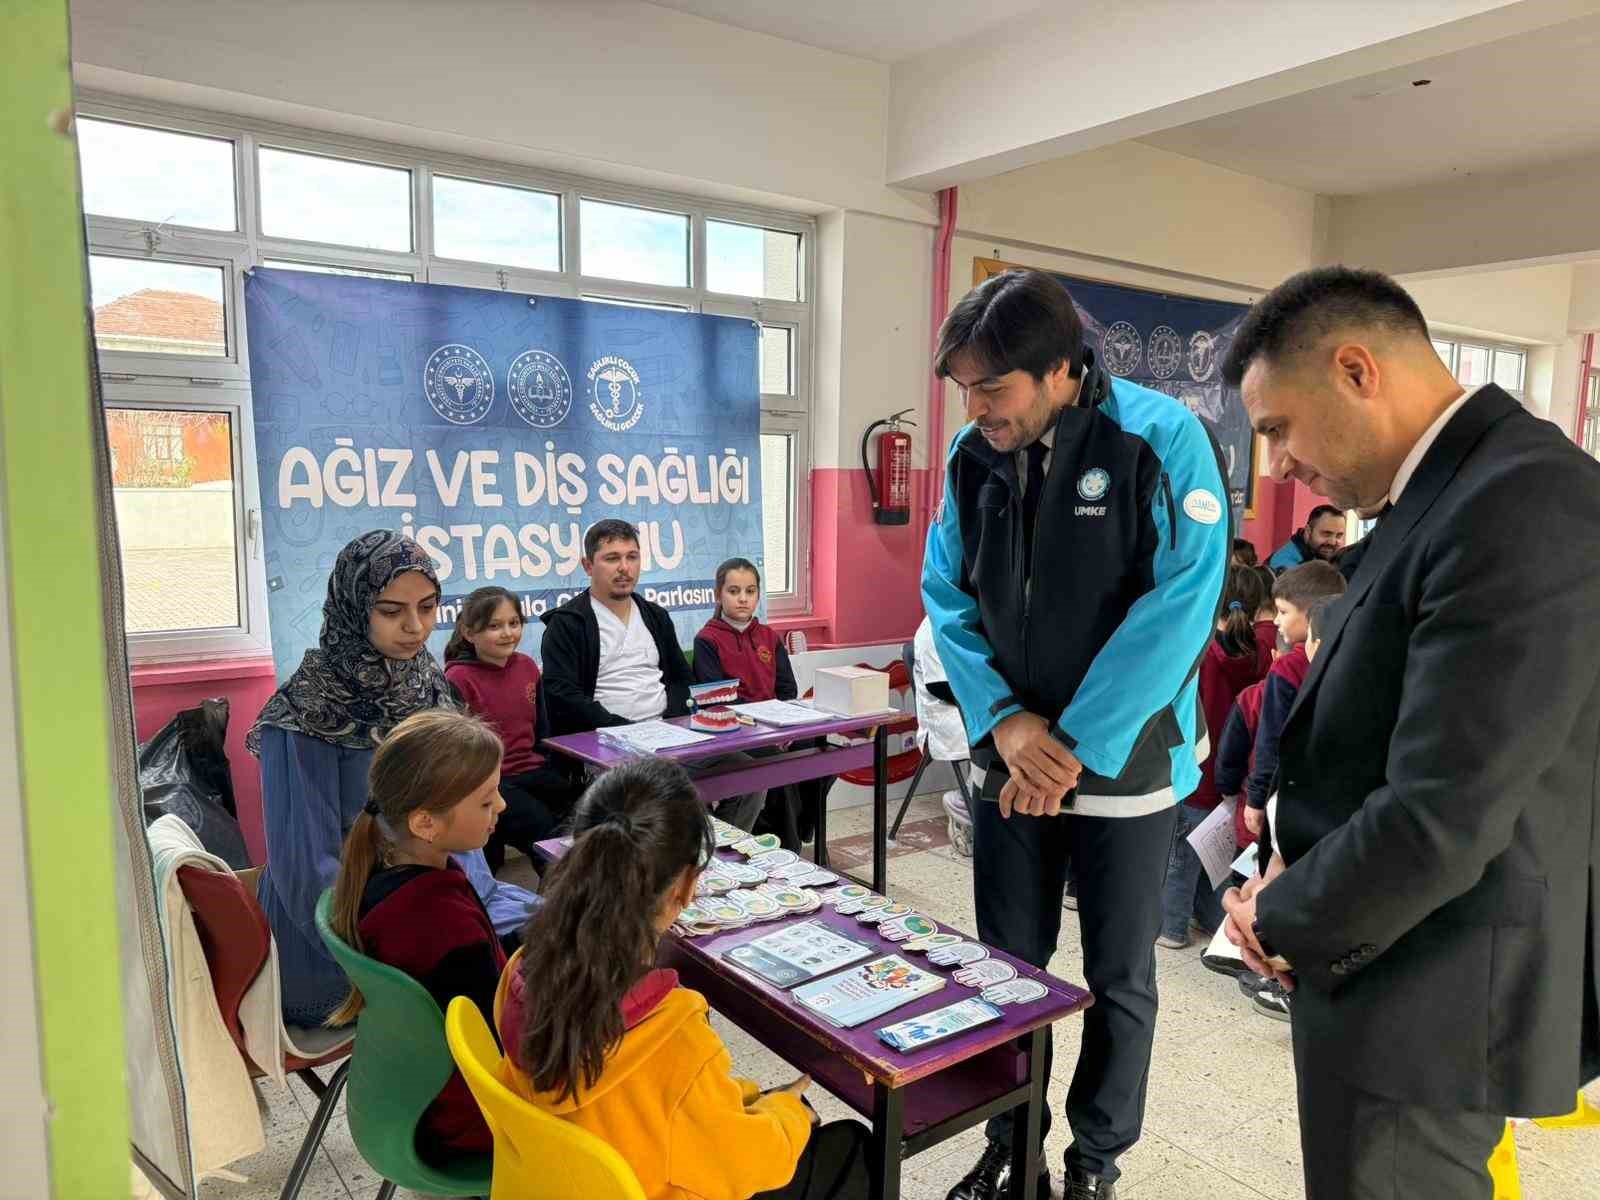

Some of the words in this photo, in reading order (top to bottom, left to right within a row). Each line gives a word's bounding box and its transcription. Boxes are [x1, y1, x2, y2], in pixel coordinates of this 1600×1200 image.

[279, 438, 417, 509] AĞIZ
[426, 450, 503, 507] VE
[514, 440, 588, 515] DİŞ
[597, 447, 749, 506] SAĞLIĞI
[401, 511, 684, 582] STASYU
